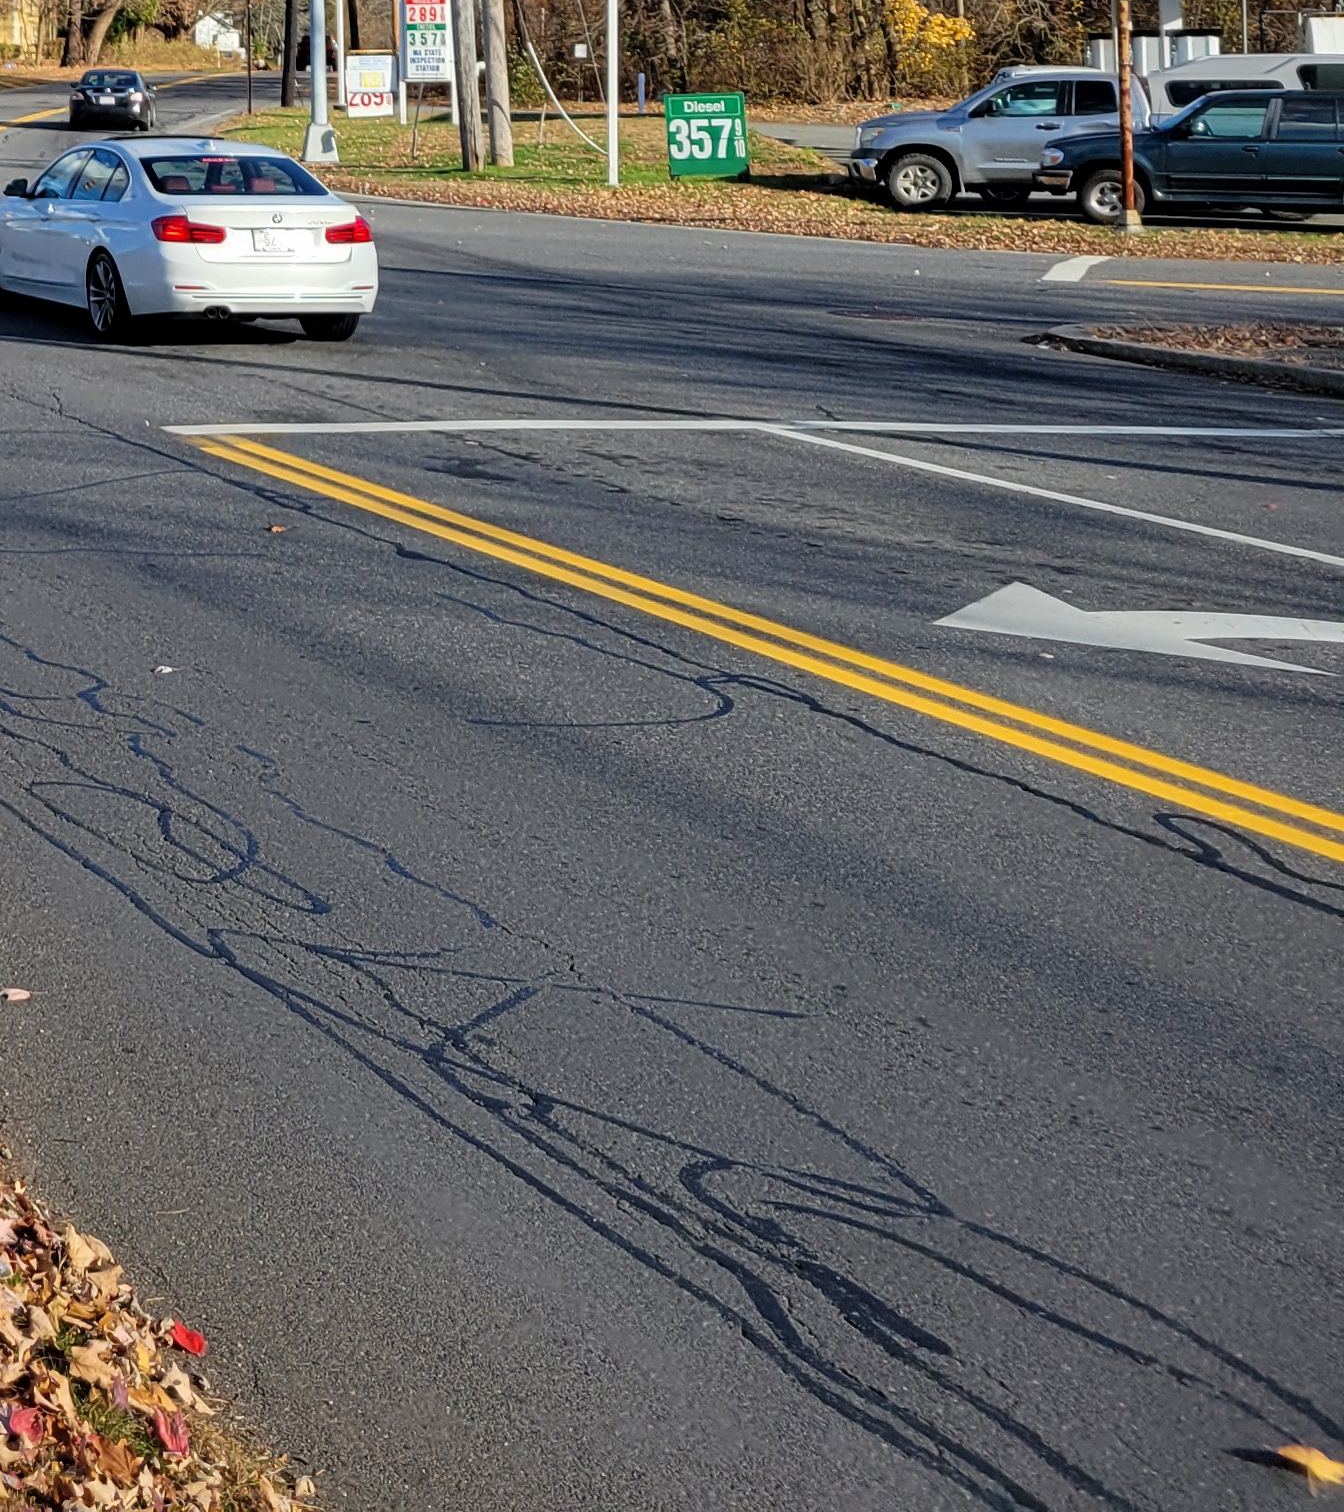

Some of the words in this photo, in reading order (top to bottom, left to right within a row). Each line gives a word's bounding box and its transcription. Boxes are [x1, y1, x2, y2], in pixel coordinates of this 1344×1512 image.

[408, 6, 437, 22] 289
[408, 32, 438, 46] 357
[683, 99, 726, 113] Diesel
[668, 118, 733, 160] 357
[734, 117, 743, 136] 9
